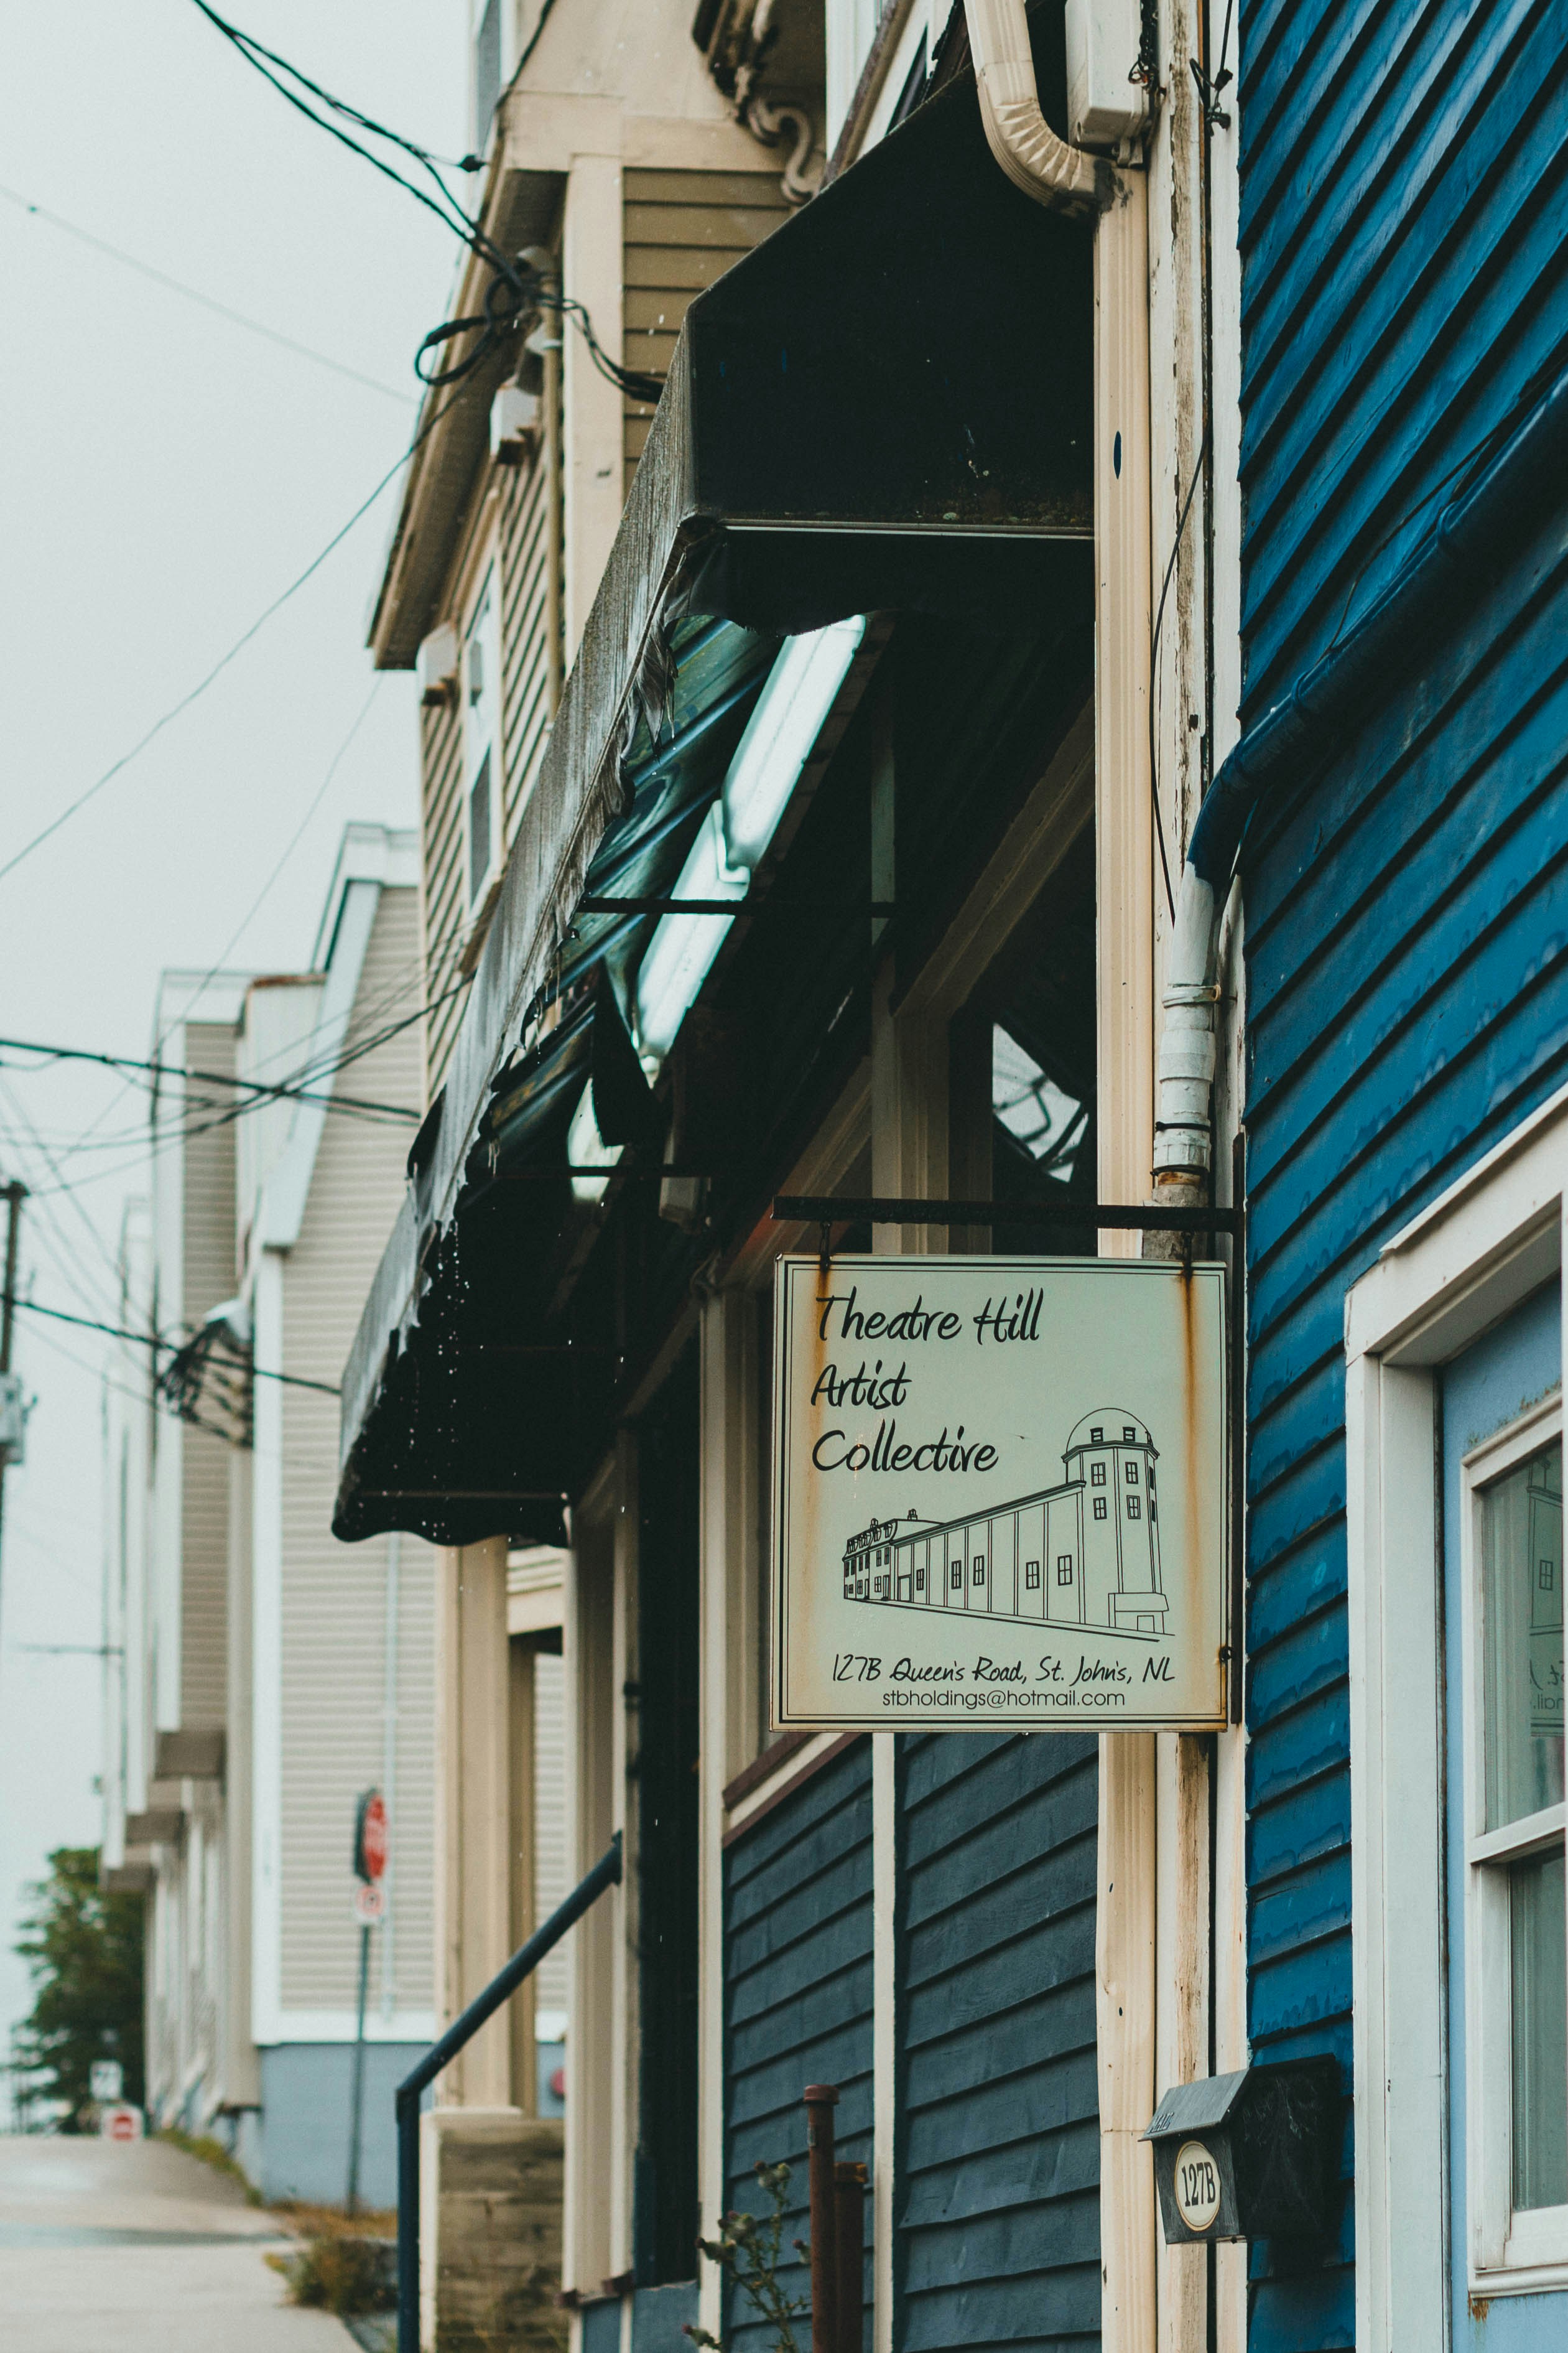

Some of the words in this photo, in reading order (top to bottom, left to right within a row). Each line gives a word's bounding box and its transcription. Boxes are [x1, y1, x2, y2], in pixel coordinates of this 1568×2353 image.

[815, 1285, 962, 1341] Theatre
[973, 1287, 1044, 1345] Hill
[810, 1359, 912, 1410] Artist
[812, 1419, 999, 1472] Collective
[833, 1654, 882, 1682] 127B
[889, 1657, 965, 1682] Queen's
[972, 1656, 1027, 1685] Road,
[1035, 1656, 1064, 1682] St.
[1069, 1656, 1132, 1687] John's,
[1142, 1656, 1176, 1683] NL
[883, 1689, 1125, 1710] stbholdings@hotmail.com
[1181, 2161, 1217, 2207] 127B
